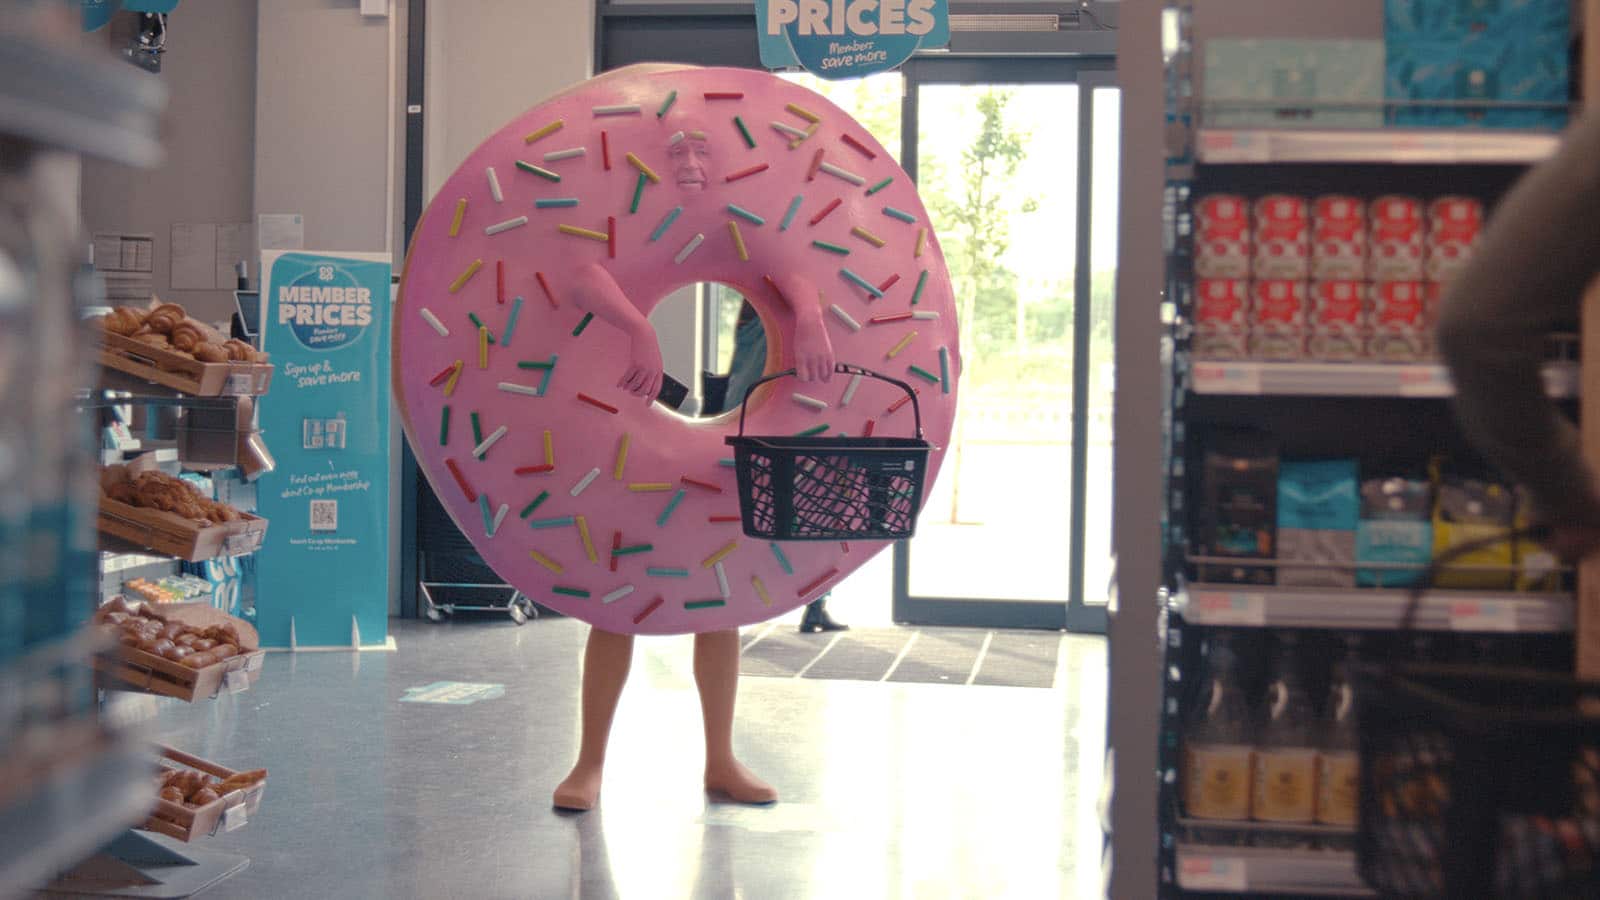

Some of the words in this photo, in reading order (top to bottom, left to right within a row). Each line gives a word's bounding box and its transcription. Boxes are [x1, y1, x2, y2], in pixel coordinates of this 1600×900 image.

[768, 0, 935, 36] PRICES
[829, 40, 874, 54] Members
[821, 55, 853, 69] save
[854, 51, 887, 64] more
[279, 286, 371, 303] MEMBER
[279, 304, 372, 326] PRICES
[284, 362, 307, 378] Sign
[308, 364, 321, 375] up
[297, 376, 327, 388] save
[328, 371, 361, 383] more
